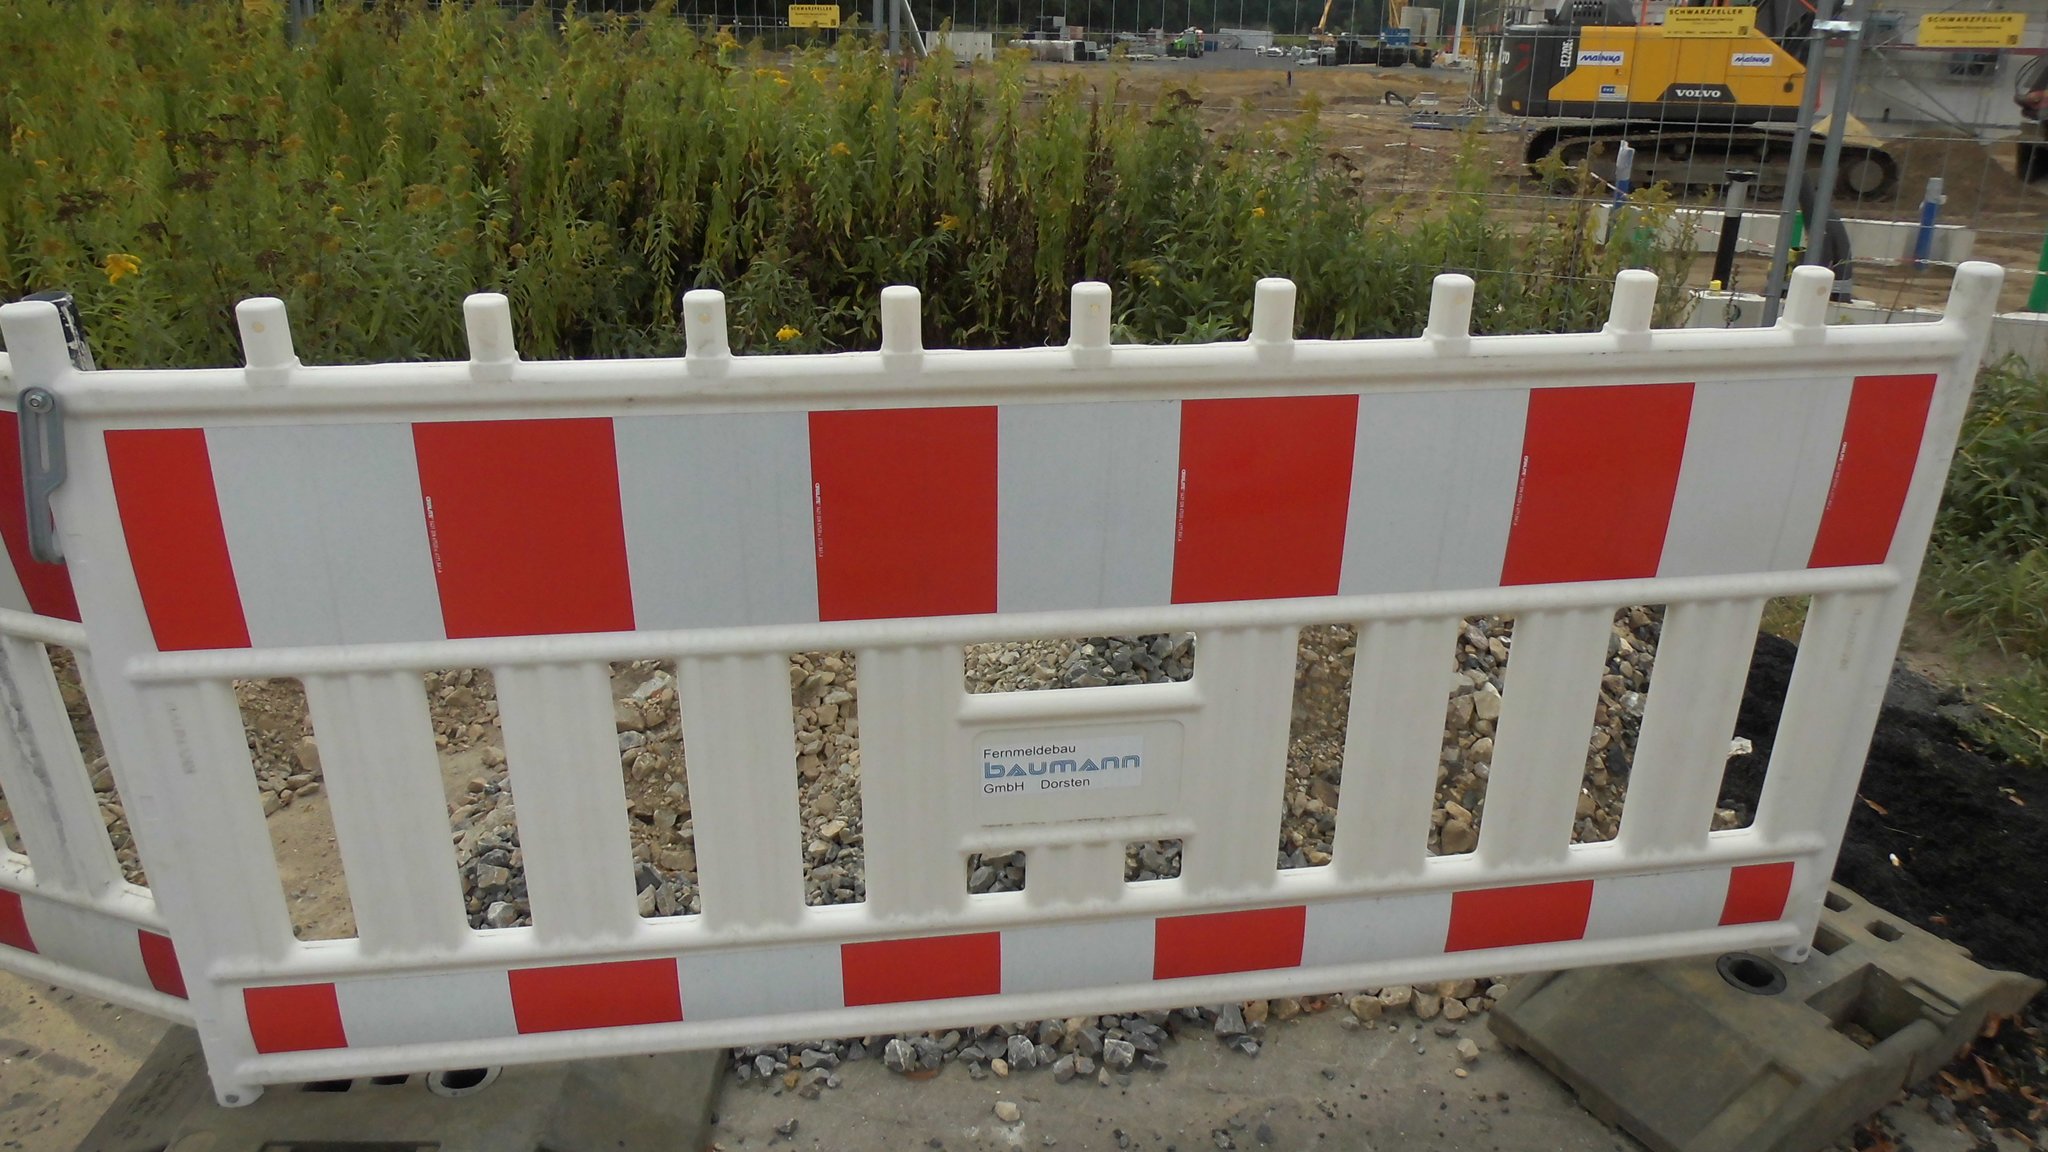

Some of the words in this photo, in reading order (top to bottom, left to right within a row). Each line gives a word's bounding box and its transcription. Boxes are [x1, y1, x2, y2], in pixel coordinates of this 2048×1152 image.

[1675, 89, 1721, 98] VOLVO
[983, 744, 1076, 759] Fernmeldebau
[984, 754, 1141, 779] baumann
[983, 781, 1025, 794] GmbH
[1040, 778, 1091, 790] Dorsten
